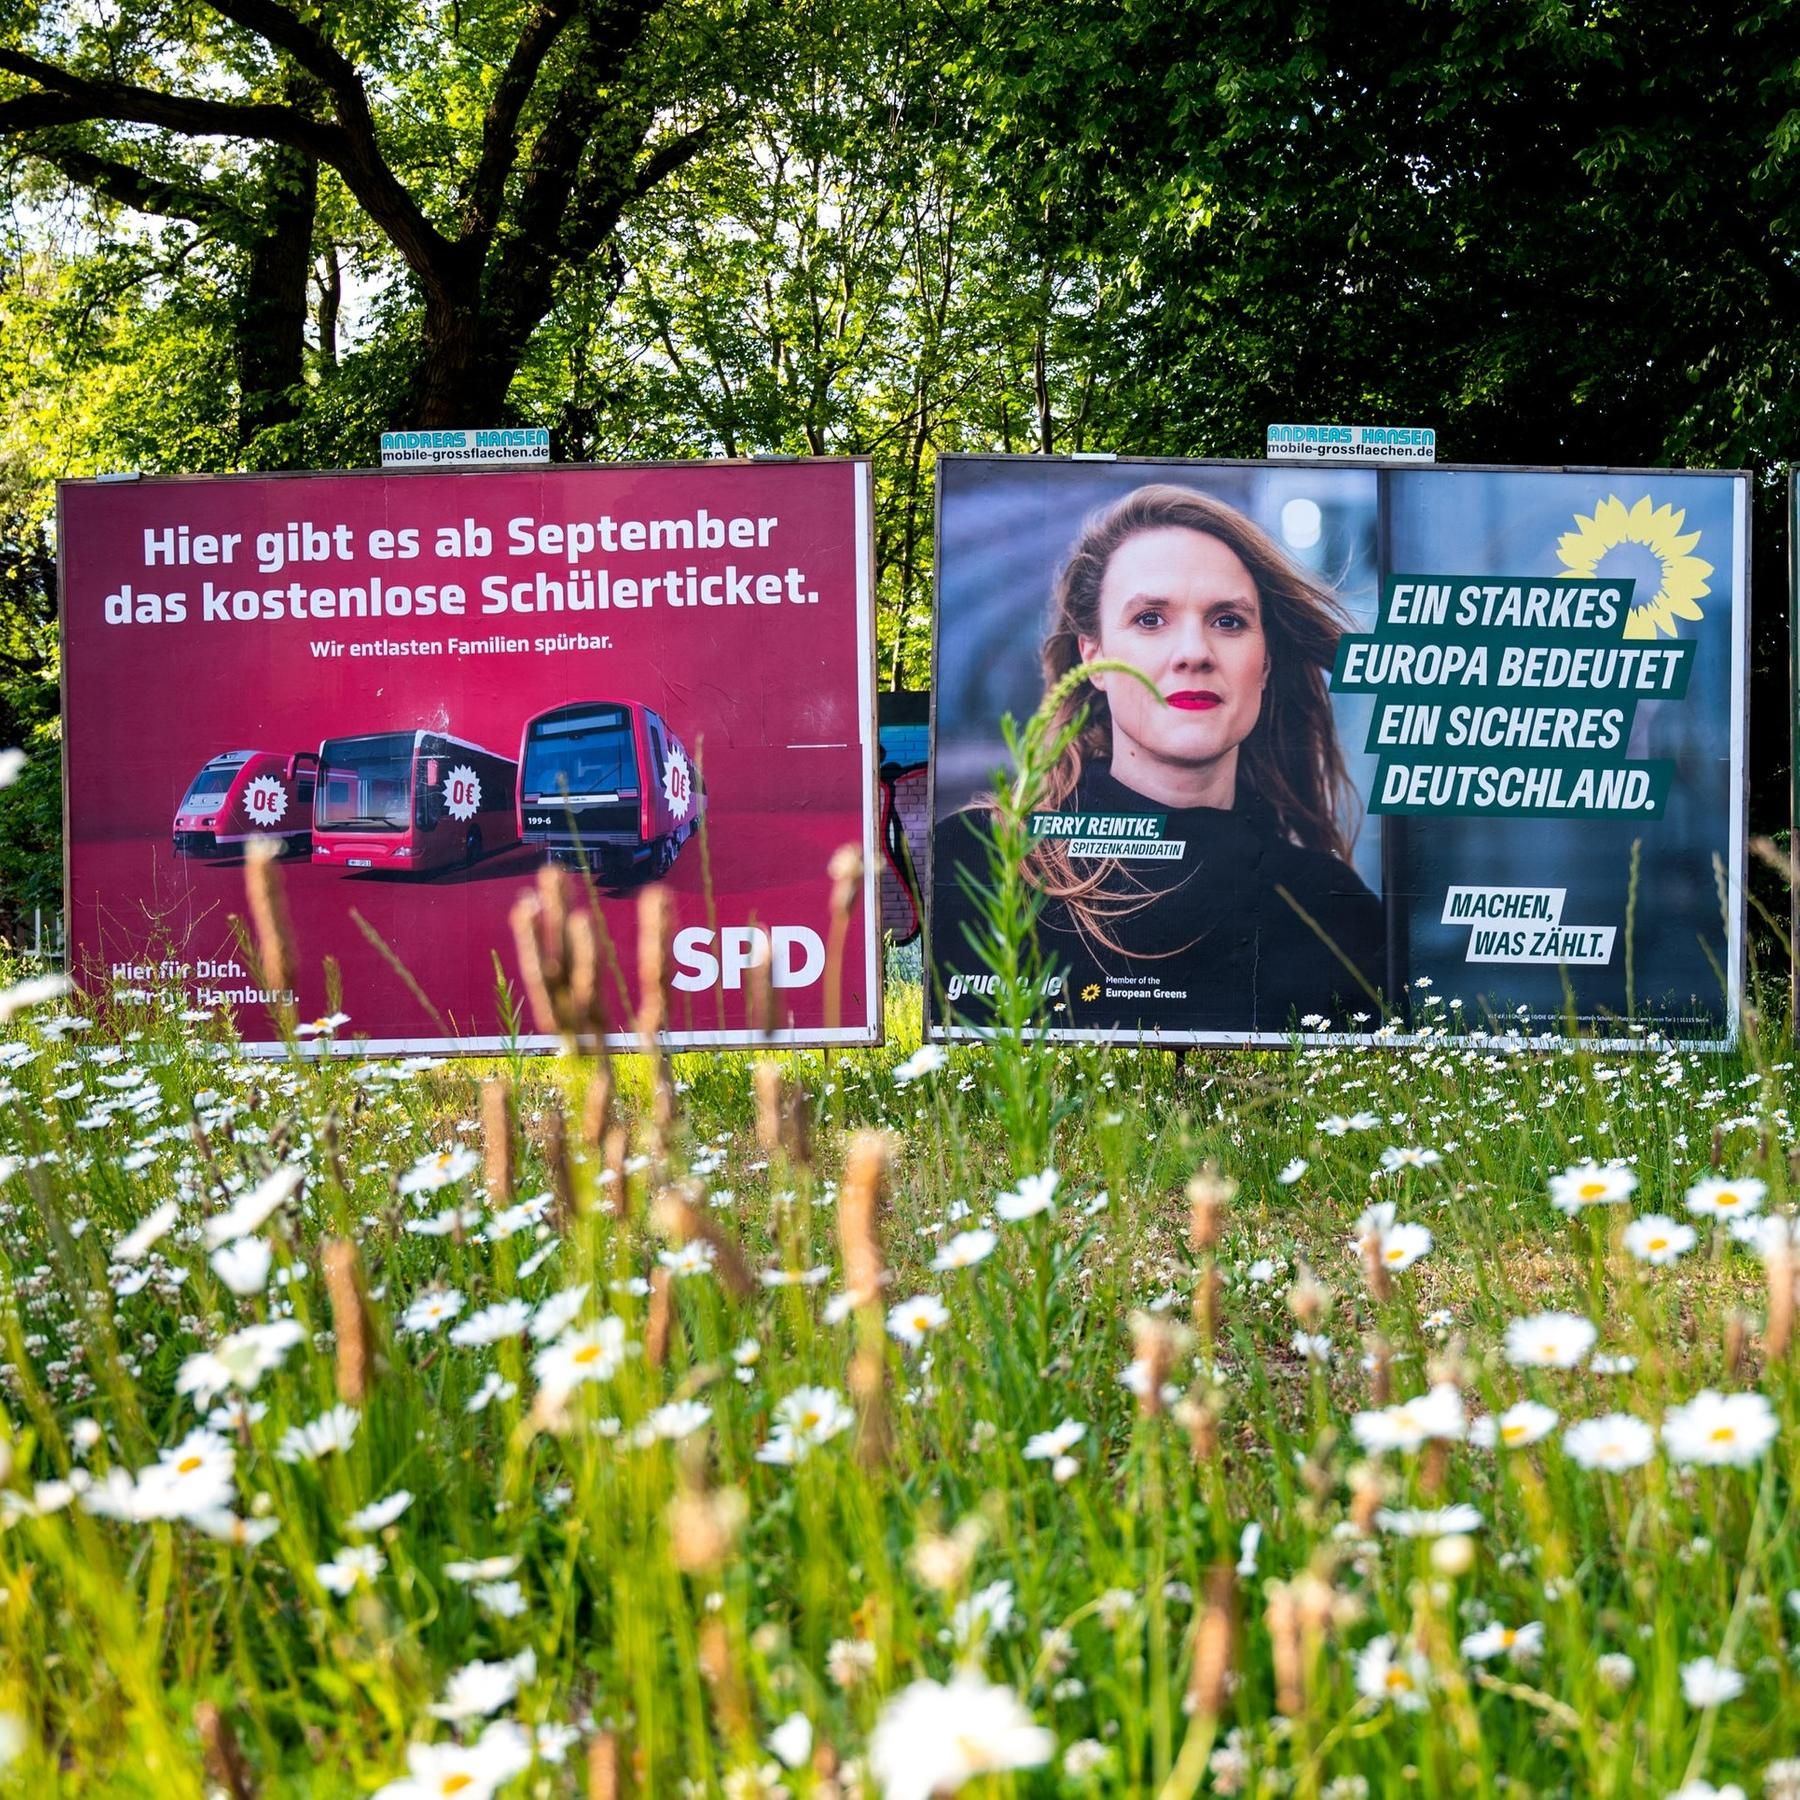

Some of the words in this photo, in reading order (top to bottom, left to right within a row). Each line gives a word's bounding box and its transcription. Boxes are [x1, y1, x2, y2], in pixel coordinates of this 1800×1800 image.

[382, 432, 466, 449] ANDREAS
[475, 430, 548, 447] HANSEN
[1268, 426, 1352, 443] ANDREAS
[1361, 428, 1434, 445] HANSEN
[383, 447, 549, 462] mobile-grossflaechen.de
[1267, 443, 1434, 457] mobile-grossflaechen.de
[144, 525, 242, 566] Hier
[256, 521, 354, 573] gibt
[368, 527, 420, 560] es
[435, 517, 493, 558] ab
[507, 509, 778, 564] September
[104, 584, 187, 625] das
[203, 577, 466, 622] kostenlose
[481, 565, 820, 615] Schülerticket.
[1387, 584, 1452, 625] EIN
[1455, 585, 1621, 629] STARKES
[310, 641, 345, 657] Wir
[349, 639, 443, 657] entlasten
[448, 636, 530, 655] Familien
[534, 633, 613, 656] spürbar.
[1342, 643, 1488, 686] EUROPA
[1496, 647, 1685, 690] BEDEUTET
[1377, 704, 1442, 745] EIN
[1445, 705, 1624, 750] SICHERES
[452, 780, 475, 805] 0€
[671, 765, 687, 801] 0€
[1381, 764, 1656, 811] DEUTSCHLAND.
[253, 789, 278, 813] 0€
[527, 816, 552, 825] 199-6
[1033, 815, 1086, 835] TERRY
[1086, 817, 1160, 839] REINTKE,
[1071, 841, 1181, 856] SPITZENKANDIDATIN
[1450, 893, 1553, 923] MACHEN,
[1474, 930, 1526, 956] WAS
[1529, 927, 1604, 958] ZÄHLT.
[112, 962, 153, 980] Hier
[197, 960, 247, 978] Dich.
[671, 926, 826, 992] SPD
[1105, 975, 1137, 985] Member
[1138, 976, 1147, 985] of
[1147, 977, 1161, 985] the
[197, 985, 299, 1006] Hamburg.
[1105, 988, 1151, 1000] European
[1153, 989, 1187, 999] Greens
